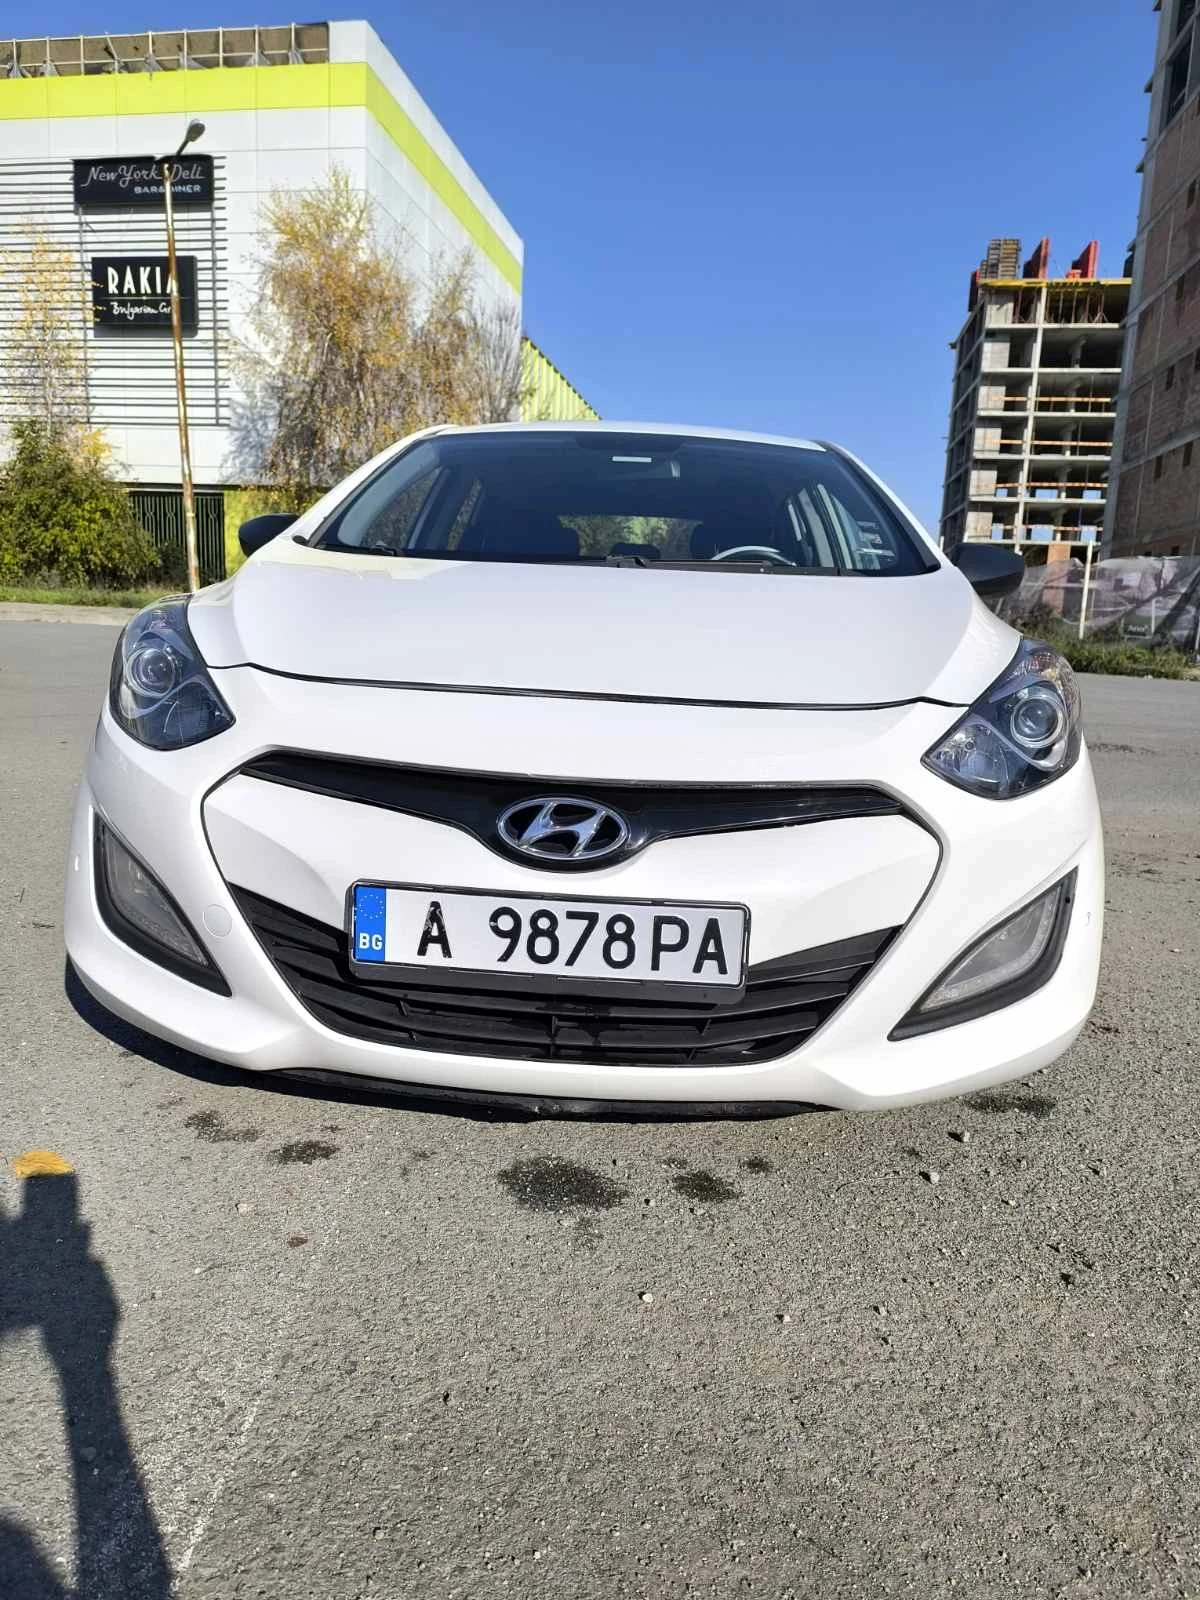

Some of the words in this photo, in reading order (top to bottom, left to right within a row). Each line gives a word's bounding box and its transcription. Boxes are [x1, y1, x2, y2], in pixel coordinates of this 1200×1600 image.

[81, 165, 118, 187] New
[119, 164, 162, 188] York
[359, 932, 383, 951] BG
[416, 900, 453, 959] A
